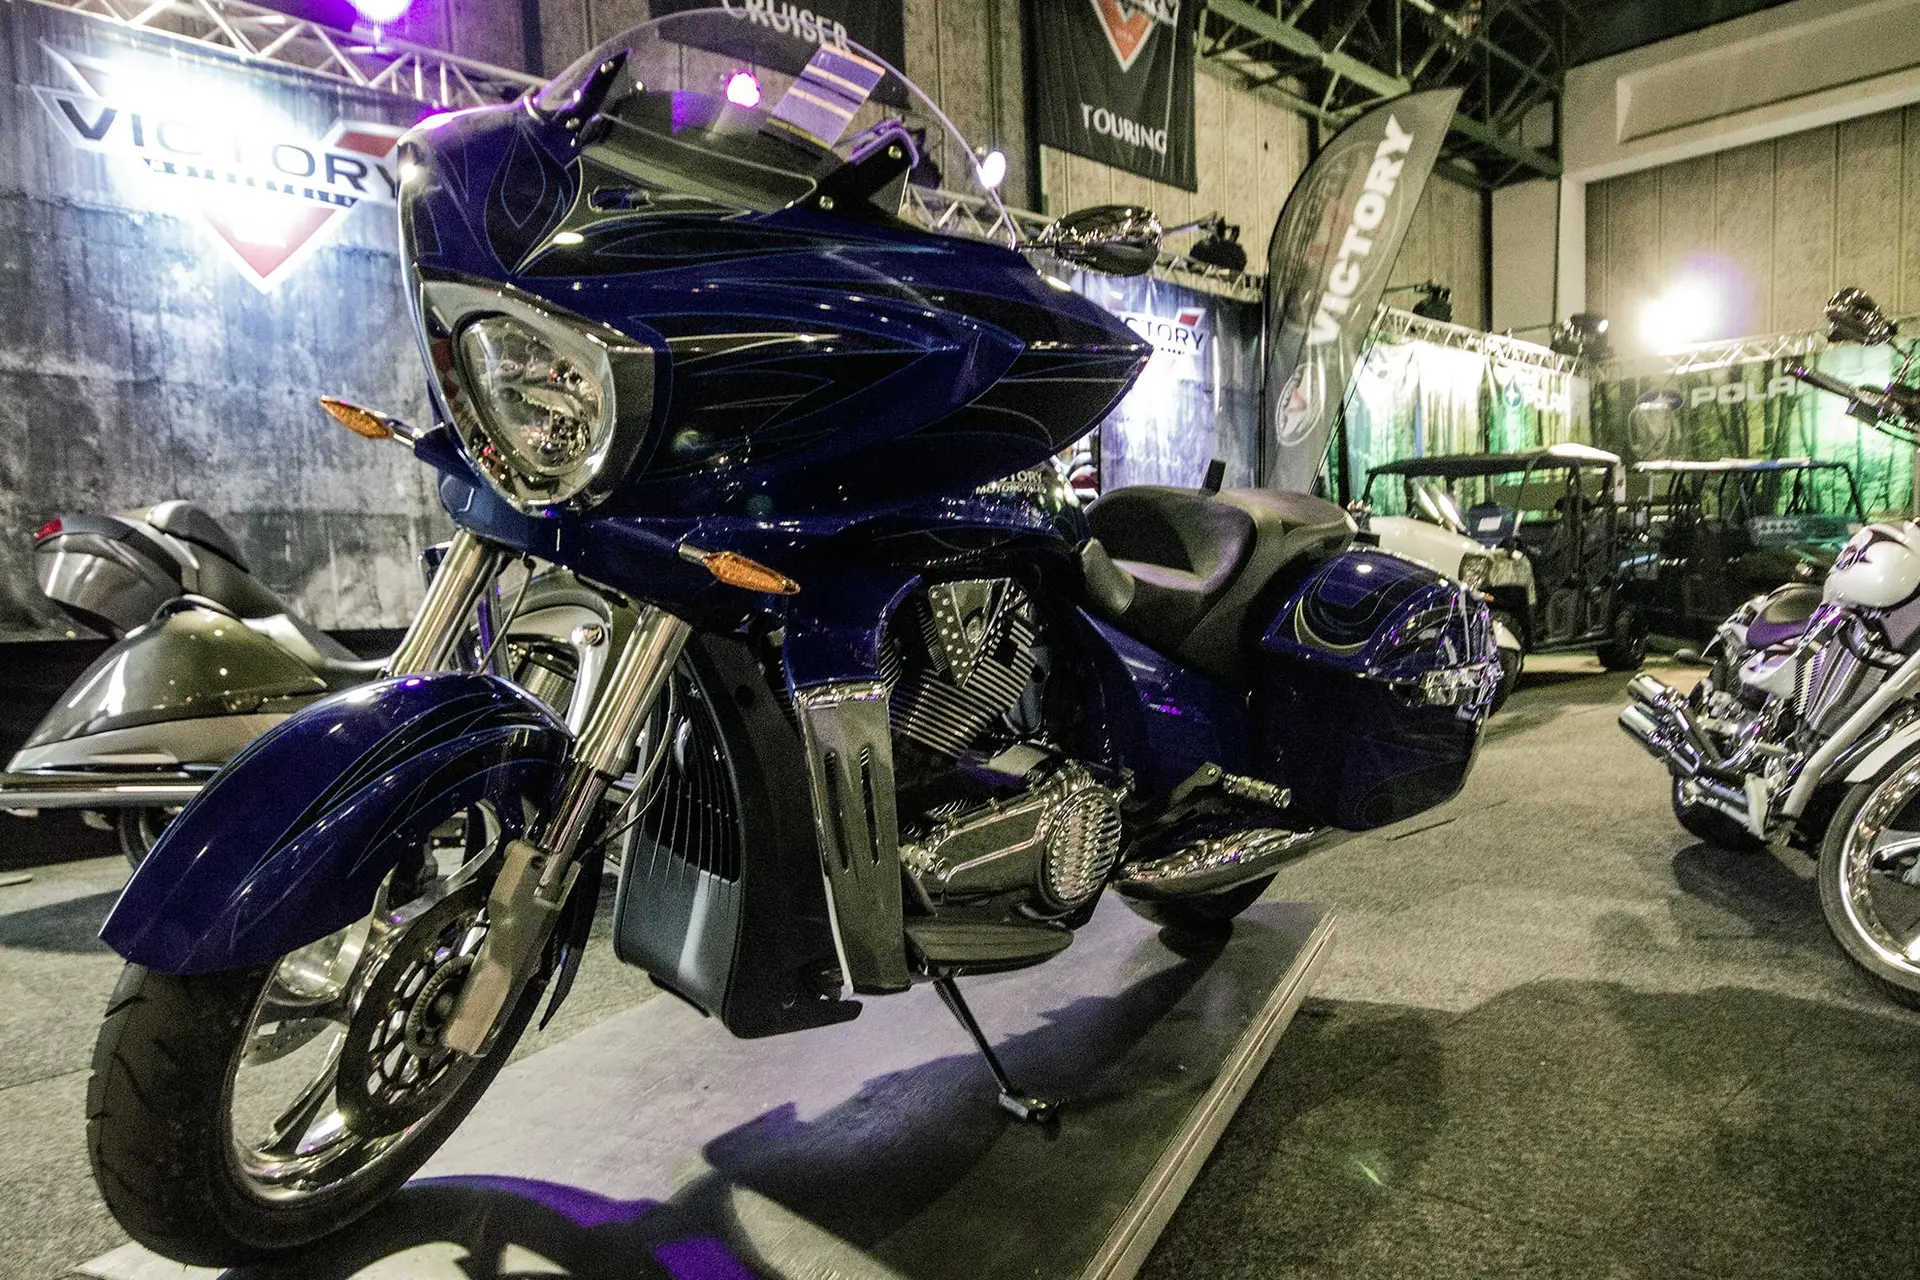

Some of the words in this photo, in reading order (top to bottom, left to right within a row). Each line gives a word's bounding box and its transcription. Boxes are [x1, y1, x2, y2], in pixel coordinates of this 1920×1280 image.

[722, 0, 852, 53] CRUISER
[1080, 102, 1167, 155] TOURING
[1306, 113, 1414, 345] VICTORY
[1691, 375, 1800, 408] POLA
